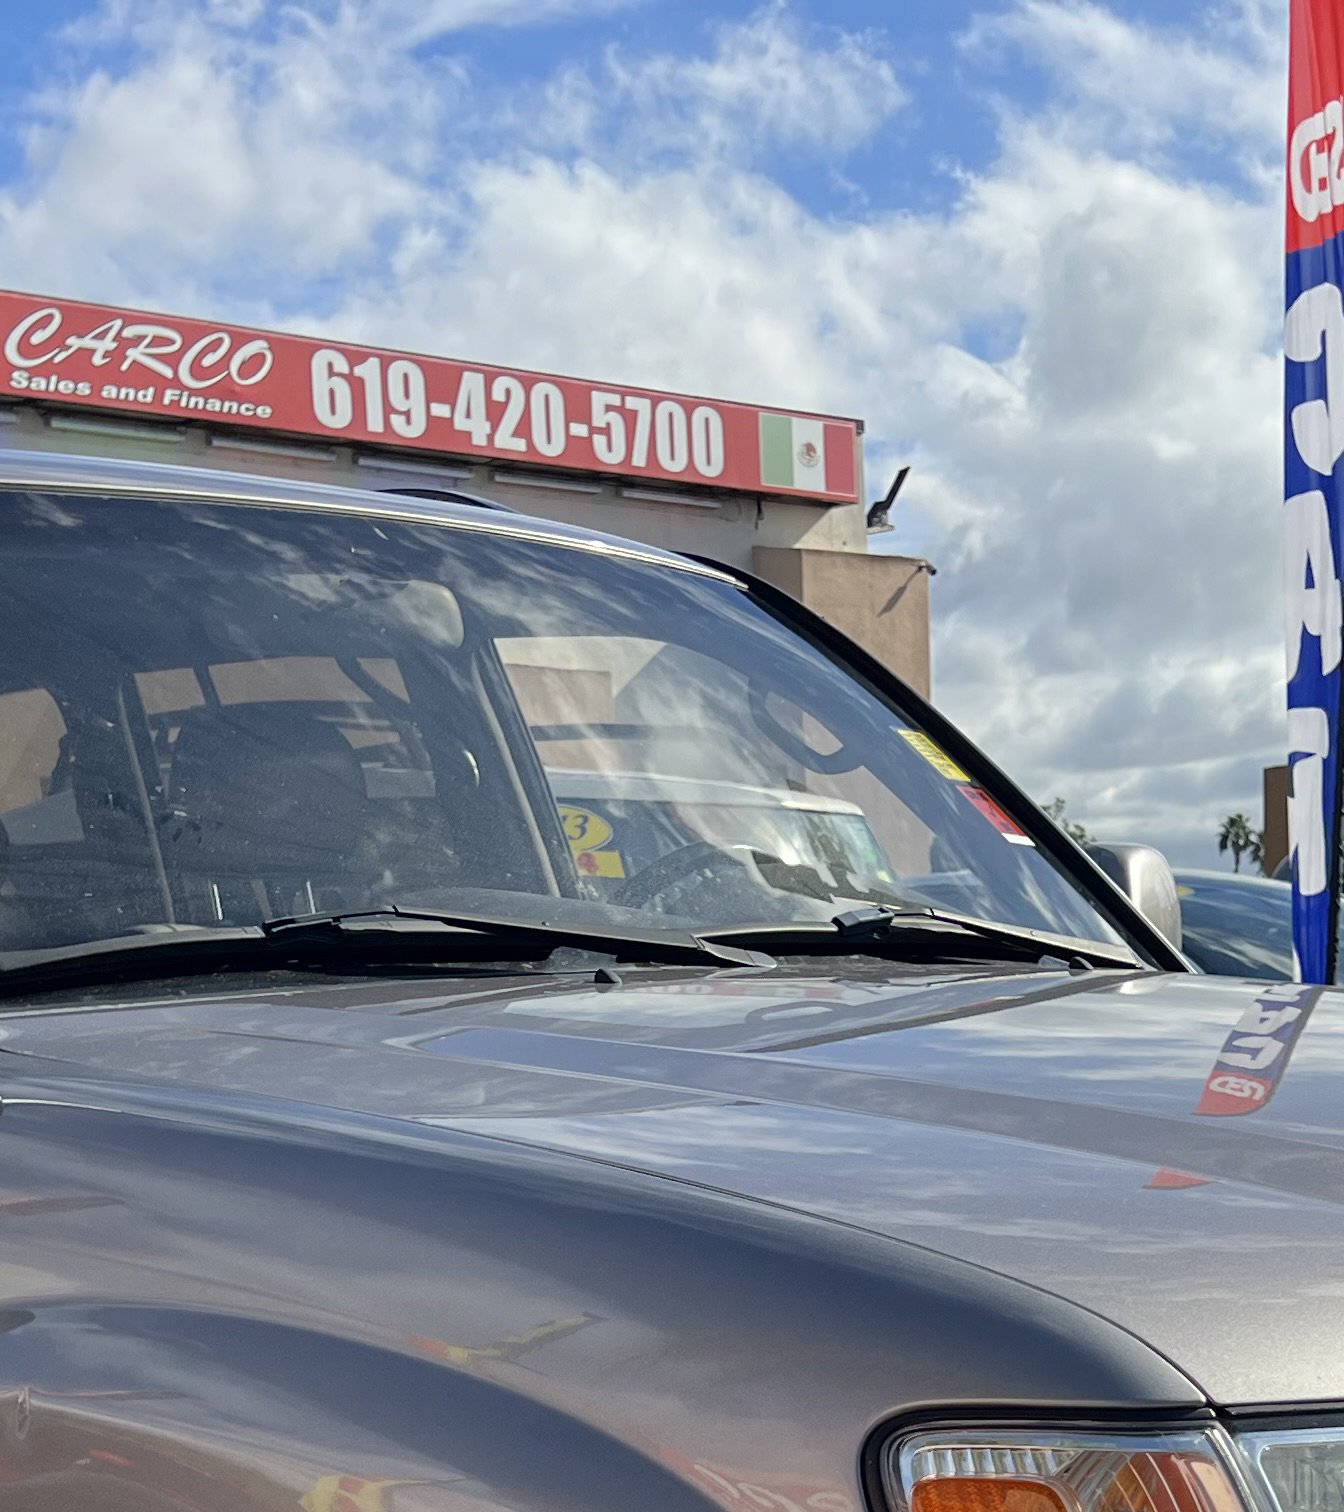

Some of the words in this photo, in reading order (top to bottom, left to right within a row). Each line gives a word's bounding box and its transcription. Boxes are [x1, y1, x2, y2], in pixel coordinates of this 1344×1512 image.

[3, 306, 274, 390] CARCO
[9, 369, 92, 396] Sales
[101, 384, 156, 405] and
[162, 387, 274, 419] Finance
[310, 347, 725, 478] 619-420-5700
